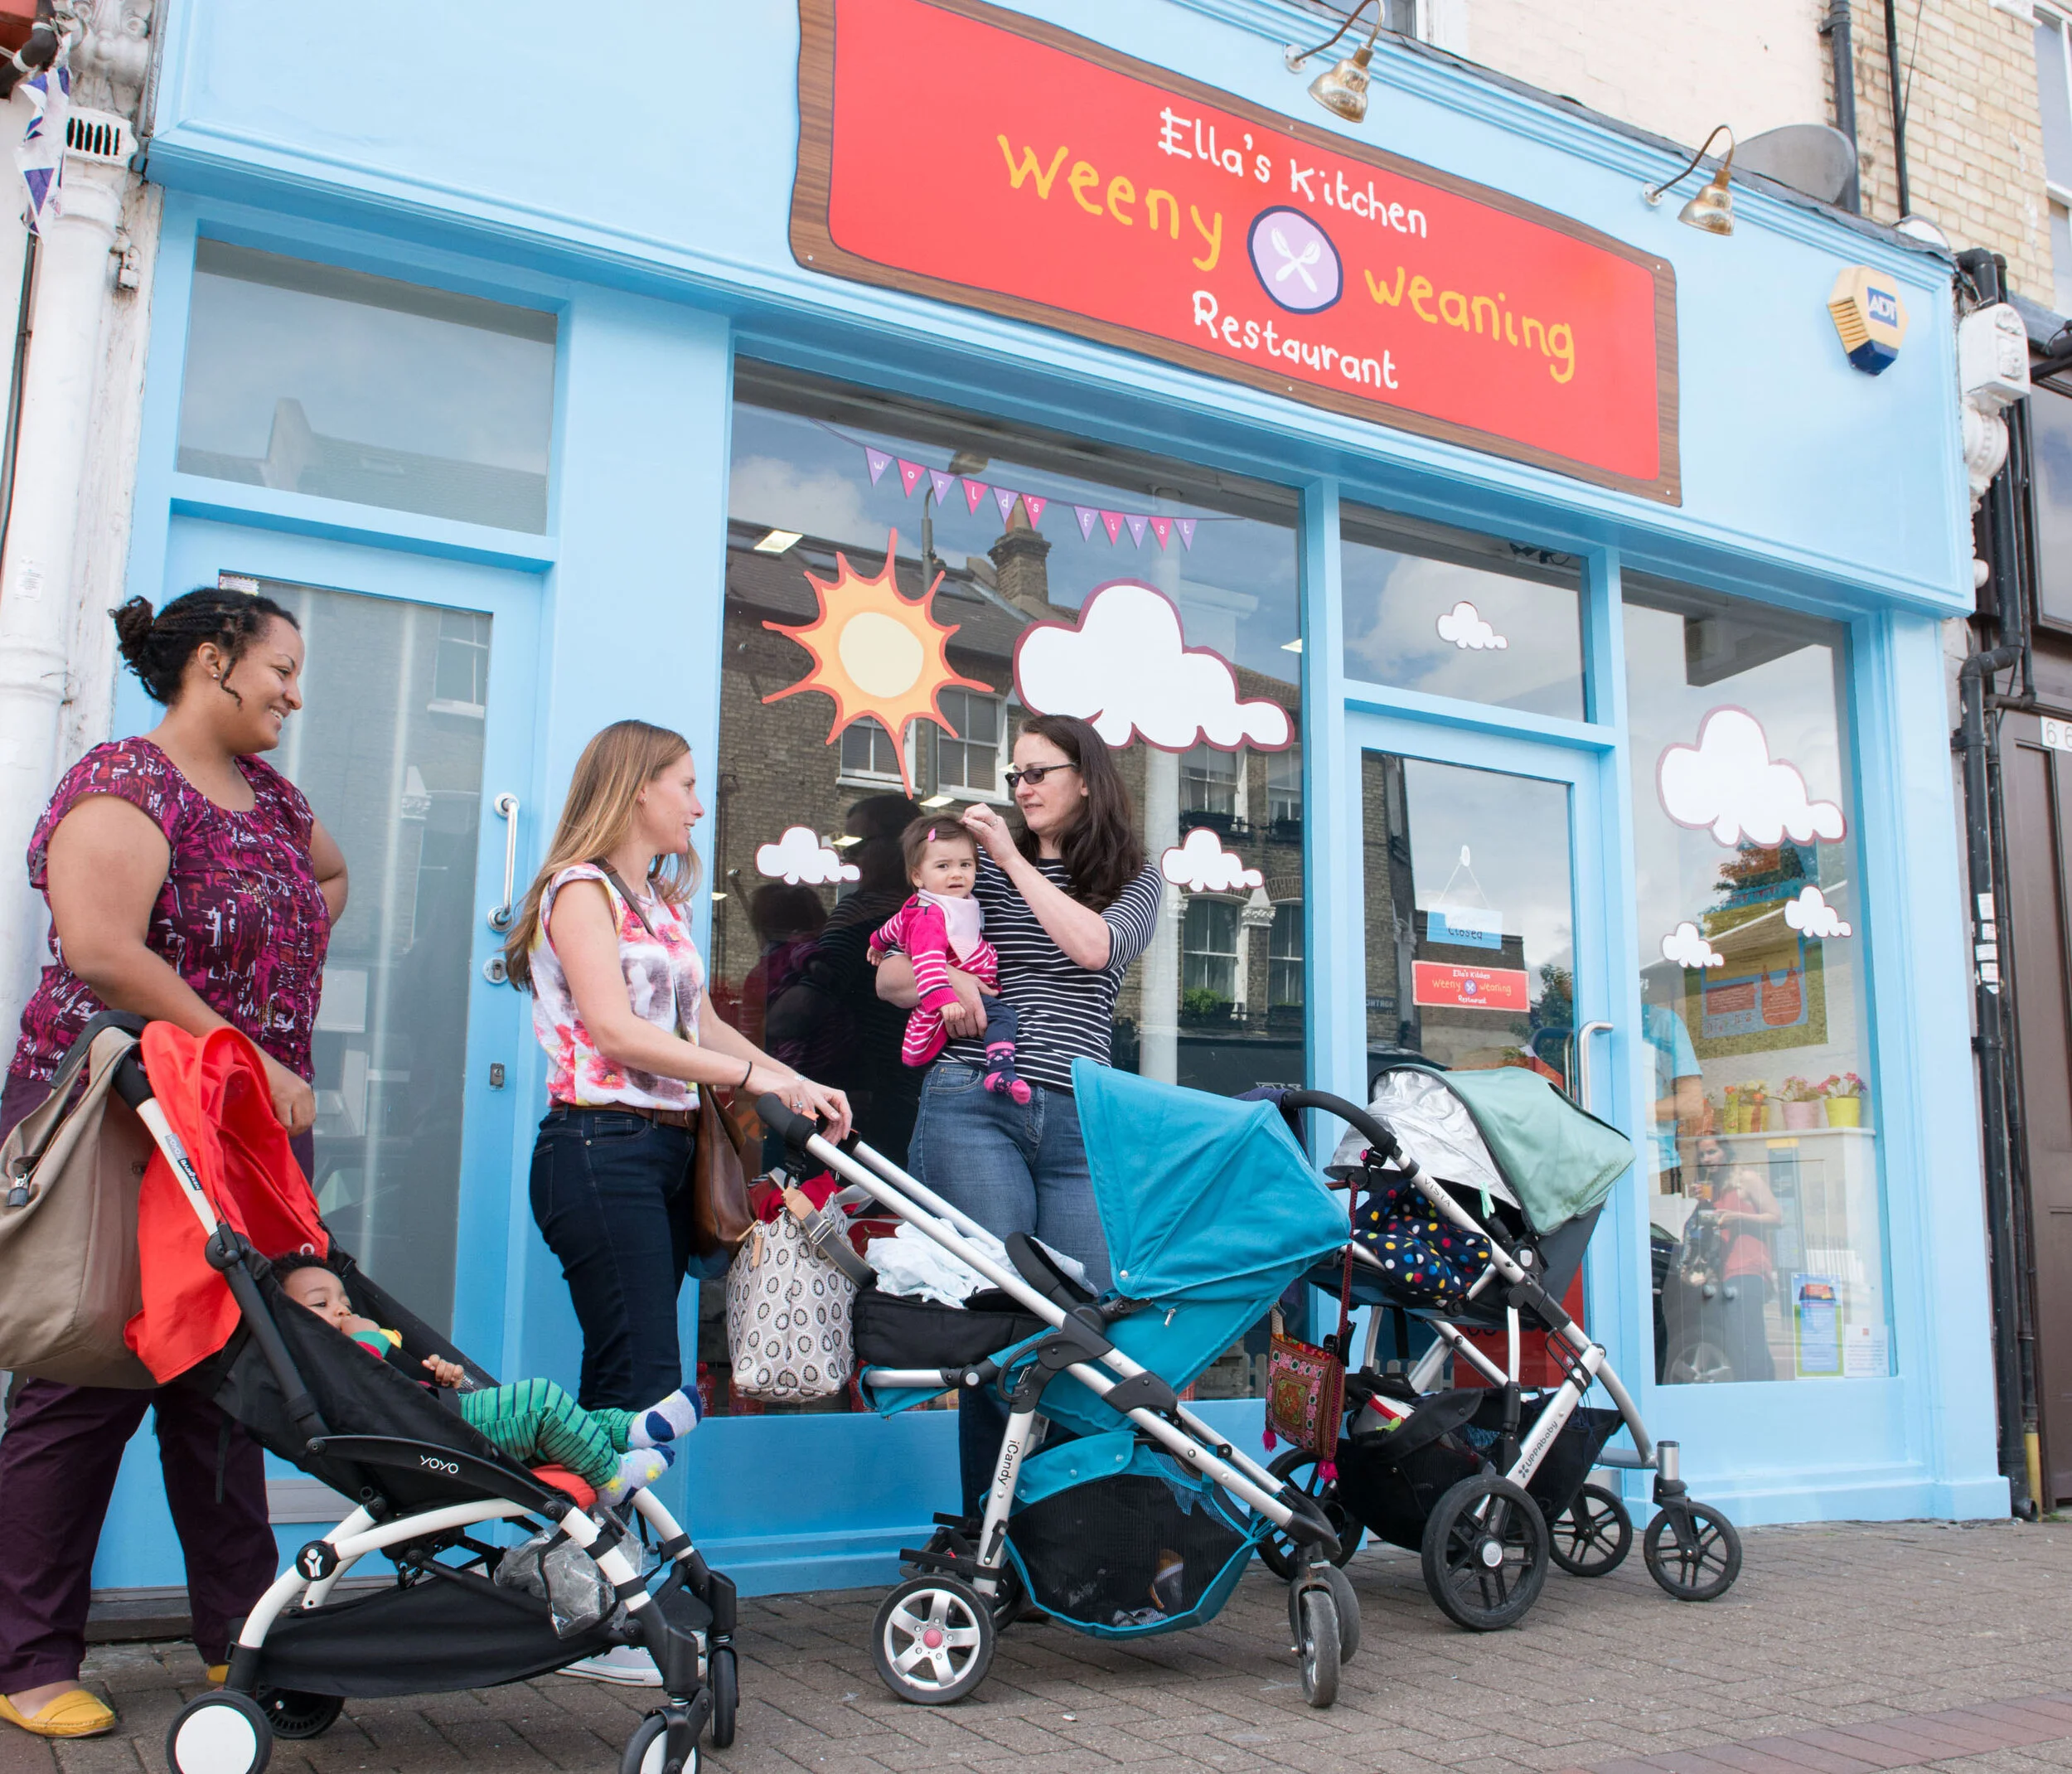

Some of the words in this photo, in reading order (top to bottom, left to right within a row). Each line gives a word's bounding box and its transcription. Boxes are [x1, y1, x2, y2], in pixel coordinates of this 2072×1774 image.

[1159, 107, 1271, 182] Ella's
[1290, 158, 1427, 238] Kitchen
[1364, 265, 1575, 383] weaning
[1869, 293, 1895, 321] ADT
[1192, 290, 1399, 390] Restaurant
[1425, 1177, 1450, 1207] VISTA
[419, 1454, 459, 1474] YOYO
[997, 1439, 1020, 1486] iCandy
